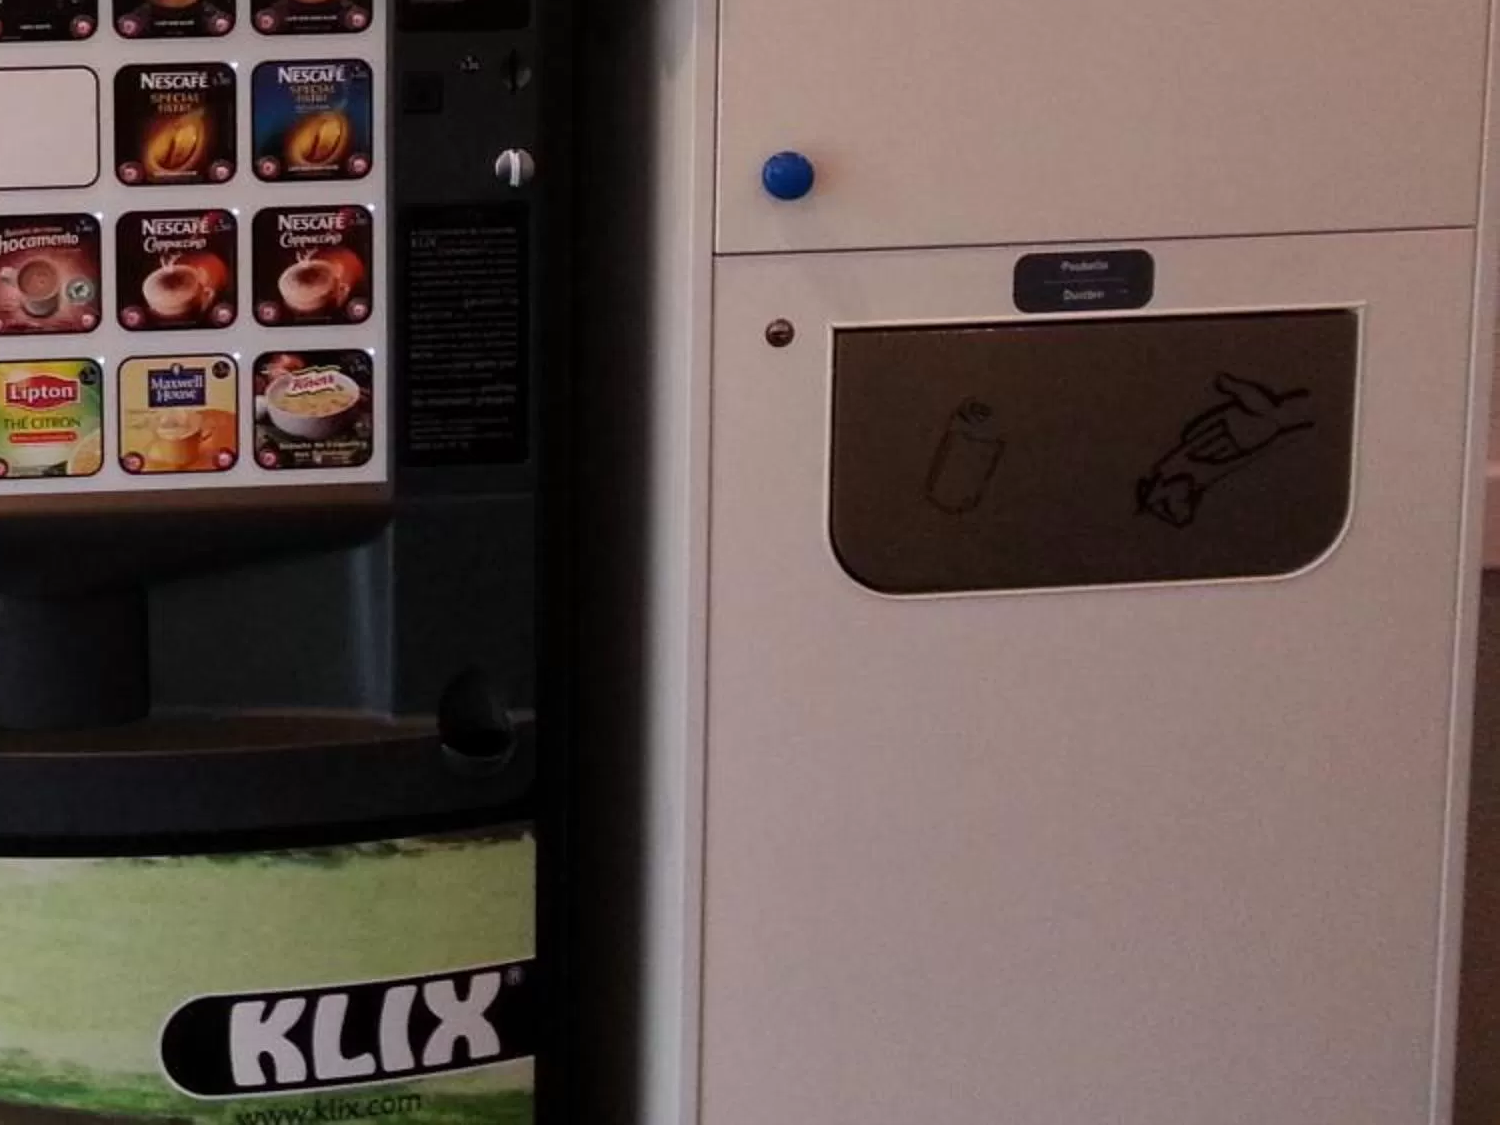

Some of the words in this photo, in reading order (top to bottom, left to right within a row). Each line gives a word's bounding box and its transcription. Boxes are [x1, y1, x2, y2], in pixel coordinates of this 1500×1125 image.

[150, 374, 203, 390] Maxwell
[9, 383, 74, 403] Lipton
[30, 416, 82, 429] CITRON
[229, 971, 501, 1088] KLIX
[235, 1092, 422, 1125] www.klix.com
